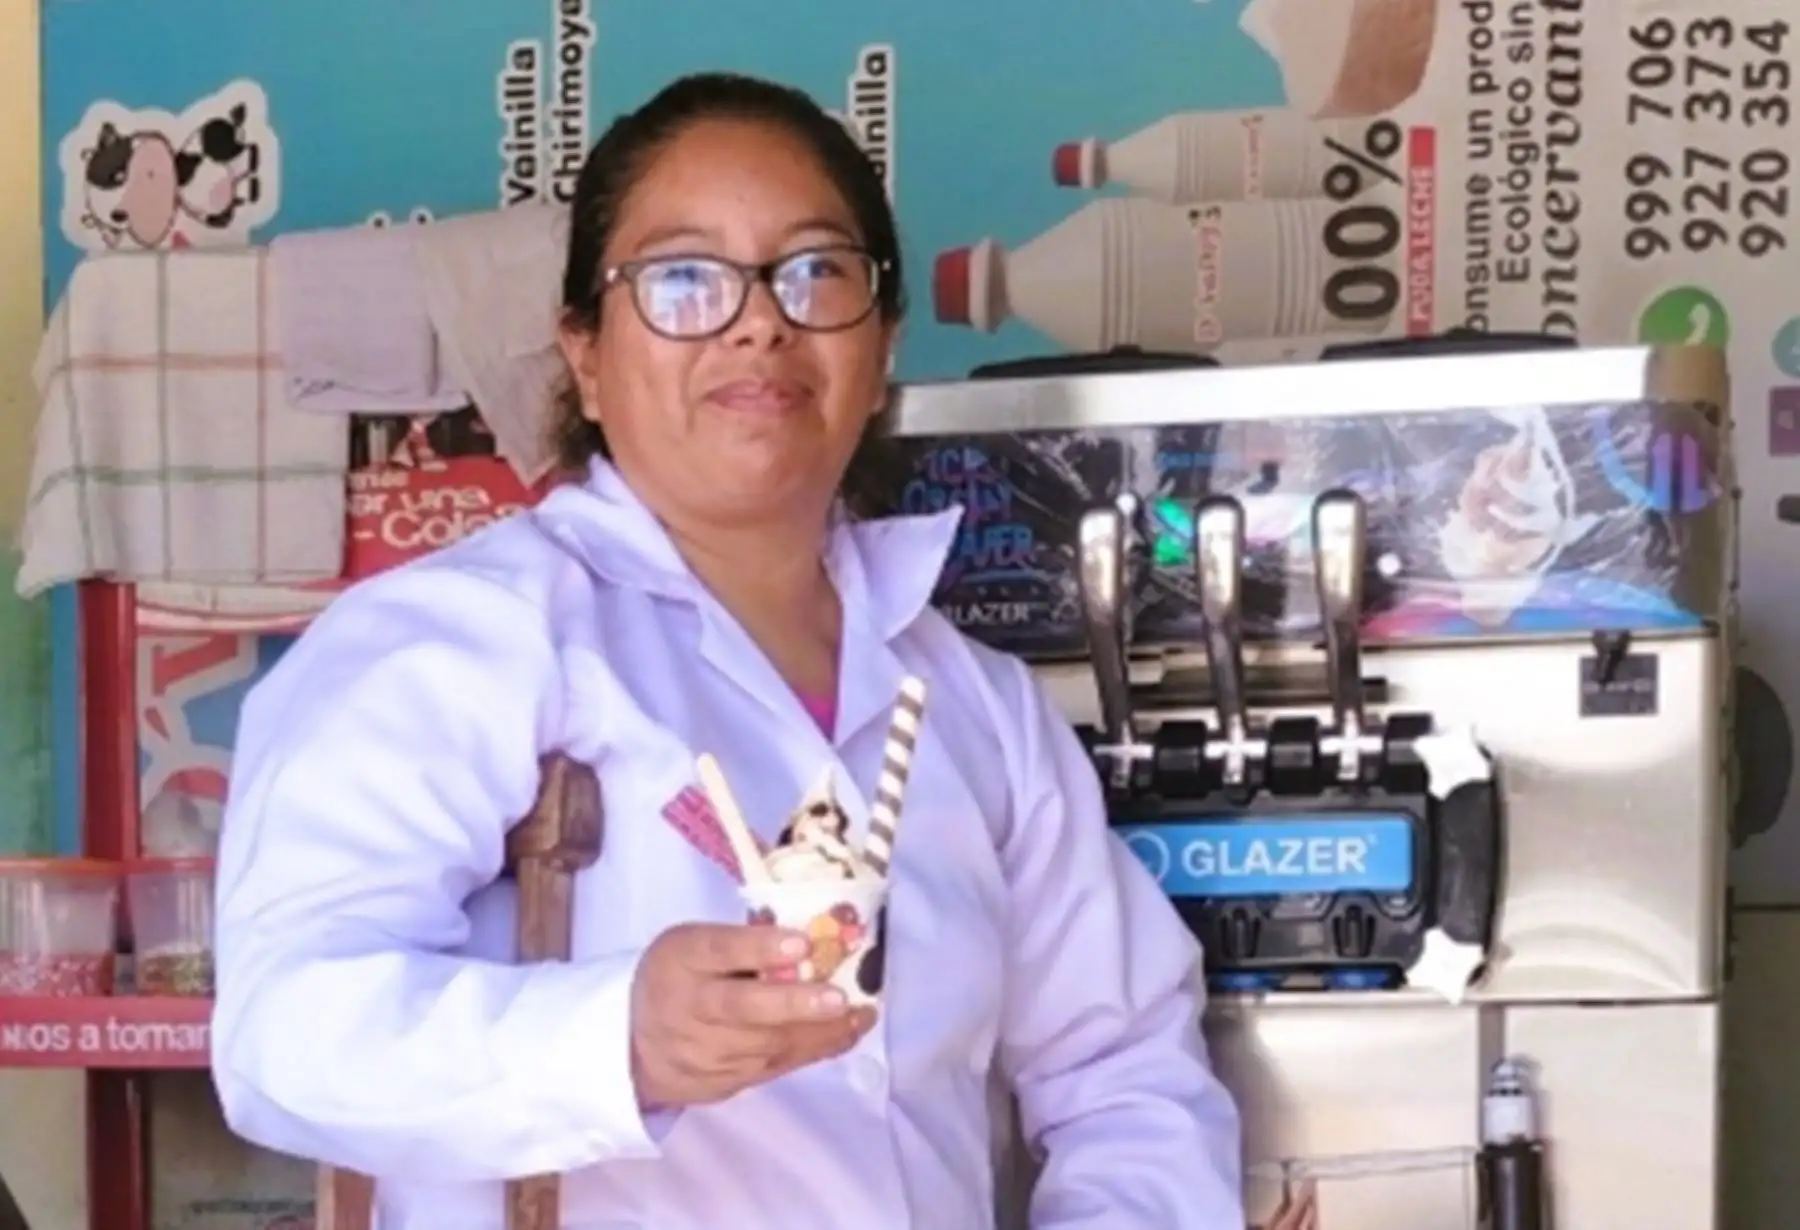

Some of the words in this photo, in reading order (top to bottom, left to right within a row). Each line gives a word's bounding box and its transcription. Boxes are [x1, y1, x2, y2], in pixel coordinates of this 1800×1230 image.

[1460, 0, 1499, 94] prod
[1500, 2, 1533, 64] sin
[1626, 18, 1675, 125] 706
[1683, 16, 1733, 123] 373
[1741, 19, 1790, 127] 354
[503, 47, 536, 205] Vainilla
[1466, 109, 1493, 160] un
[1495, 76, 1539, 283] Ecológico
[1538, 0, 1583, 335] oncervant
[1322, 119, 1403, 322] 00%
[1464, 172, 1493, 333] onsume
[1623, 153, 1671, 260] 999
[1681, 147, 1730, 252] 927
[1738, 149, 1789, 258] 920
[944, 603, 1031, 627] LAZER
[1181, 836, 1368, 878] GLAZER
[77, 1023, 101, 1051] a
